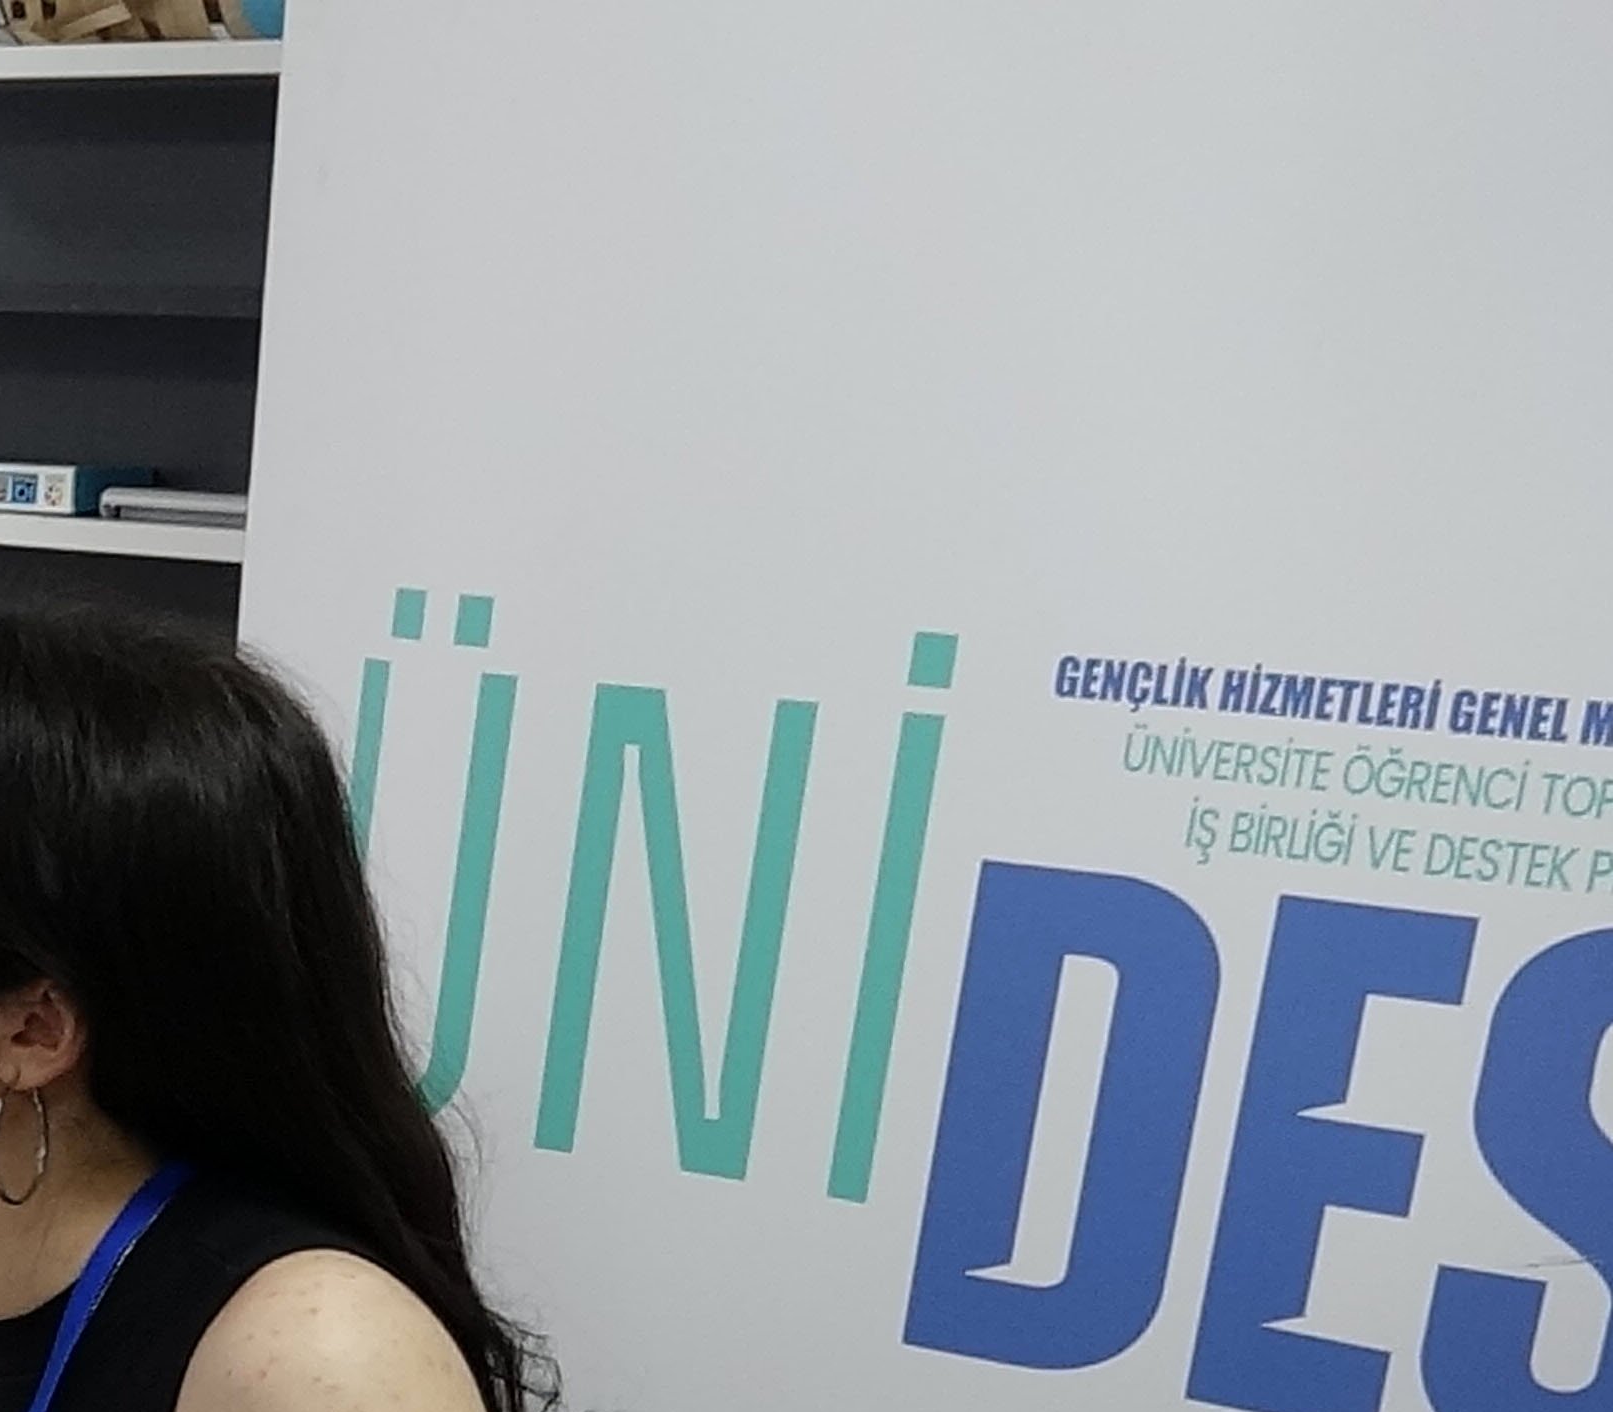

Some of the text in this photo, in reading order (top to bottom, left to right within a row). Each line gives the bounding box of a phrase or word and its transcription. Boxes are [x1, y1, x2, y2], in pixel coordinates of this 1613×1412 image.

[1054, 654, 1215, 713] GENÇLİK
[1220, 663, 1443, 730] HİZMETLERİ
[1448, 689, 1570, 742] GENEL
[1123, 722, 1336, 792] ÜNİVERSİTE
[1342, 743, 1533, 813] ÖĞRENCİ
[1184, 796, 1221, 866] İŞ
[1228, 801, 1359, 867] BİRLİĞİ
[1367, 822, 1418, 873] VE
[1423, 831, 1581, 894] DESTEK
